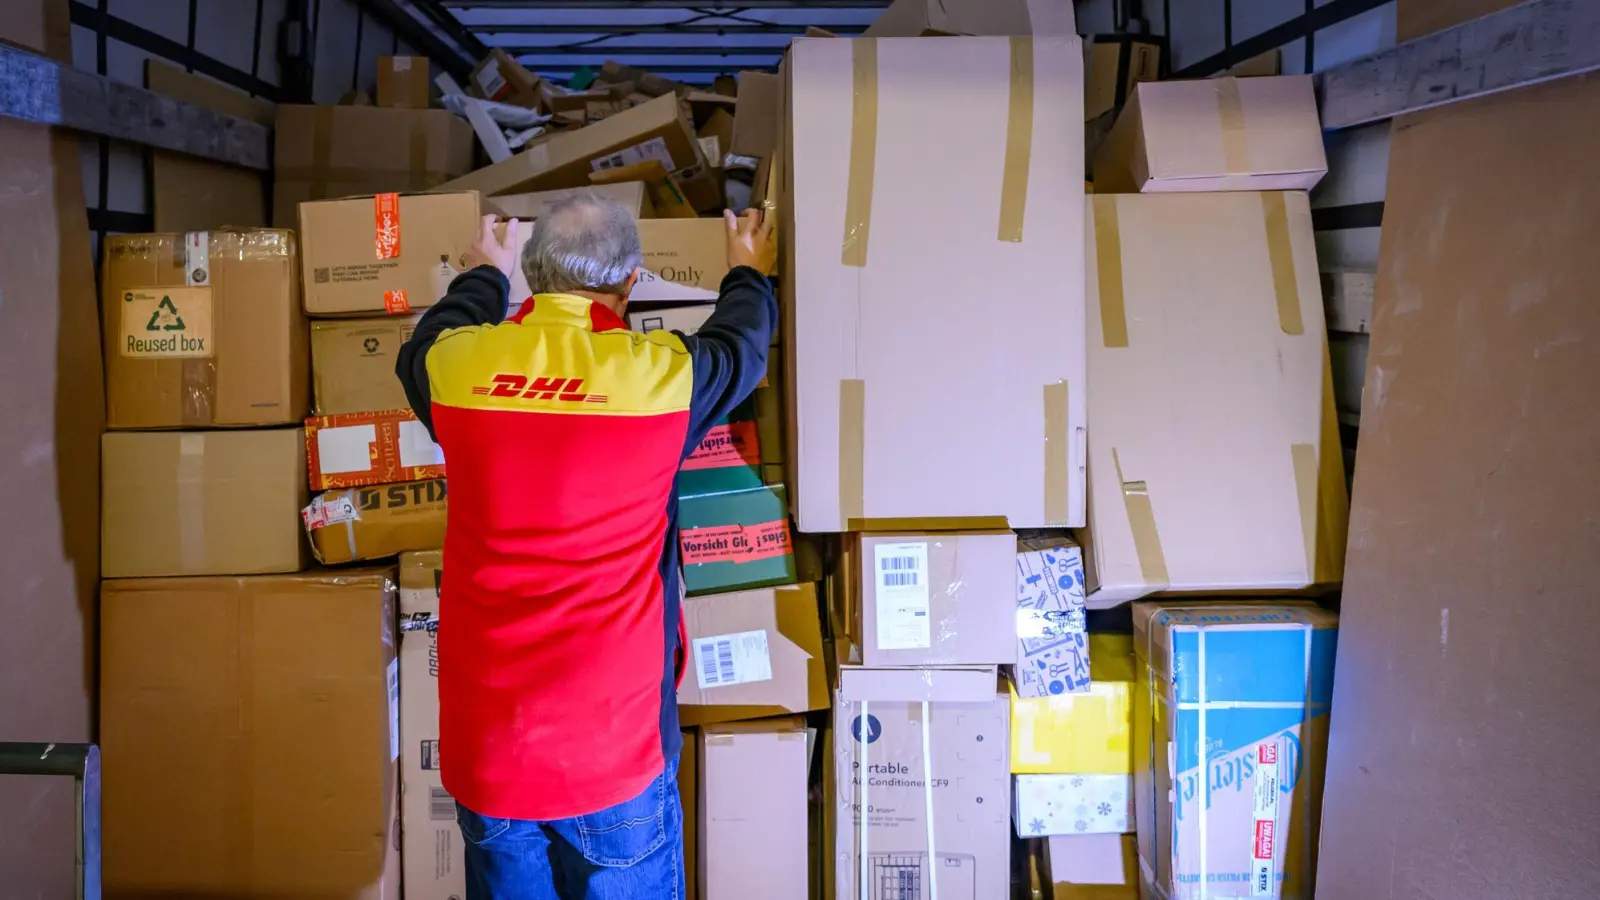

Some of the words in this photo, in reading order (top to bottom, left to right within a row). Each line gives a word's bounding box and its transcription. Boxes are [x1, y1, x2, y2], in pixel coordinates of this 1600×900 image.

[660, 266, 704, 285] Only
[127, 334, 176, 352] Reused
[181, 334, 205, 351] box
[489, 373, 587, 402] DHL
[683, 538, 728, 553] Vorsicht
[1266, 744, 1276, 763] GA!
[852, 761, 909, 775] Prtable
[852, 804, 874, 813] 900
[1262, 821, 1273, 858] UWAGA!
